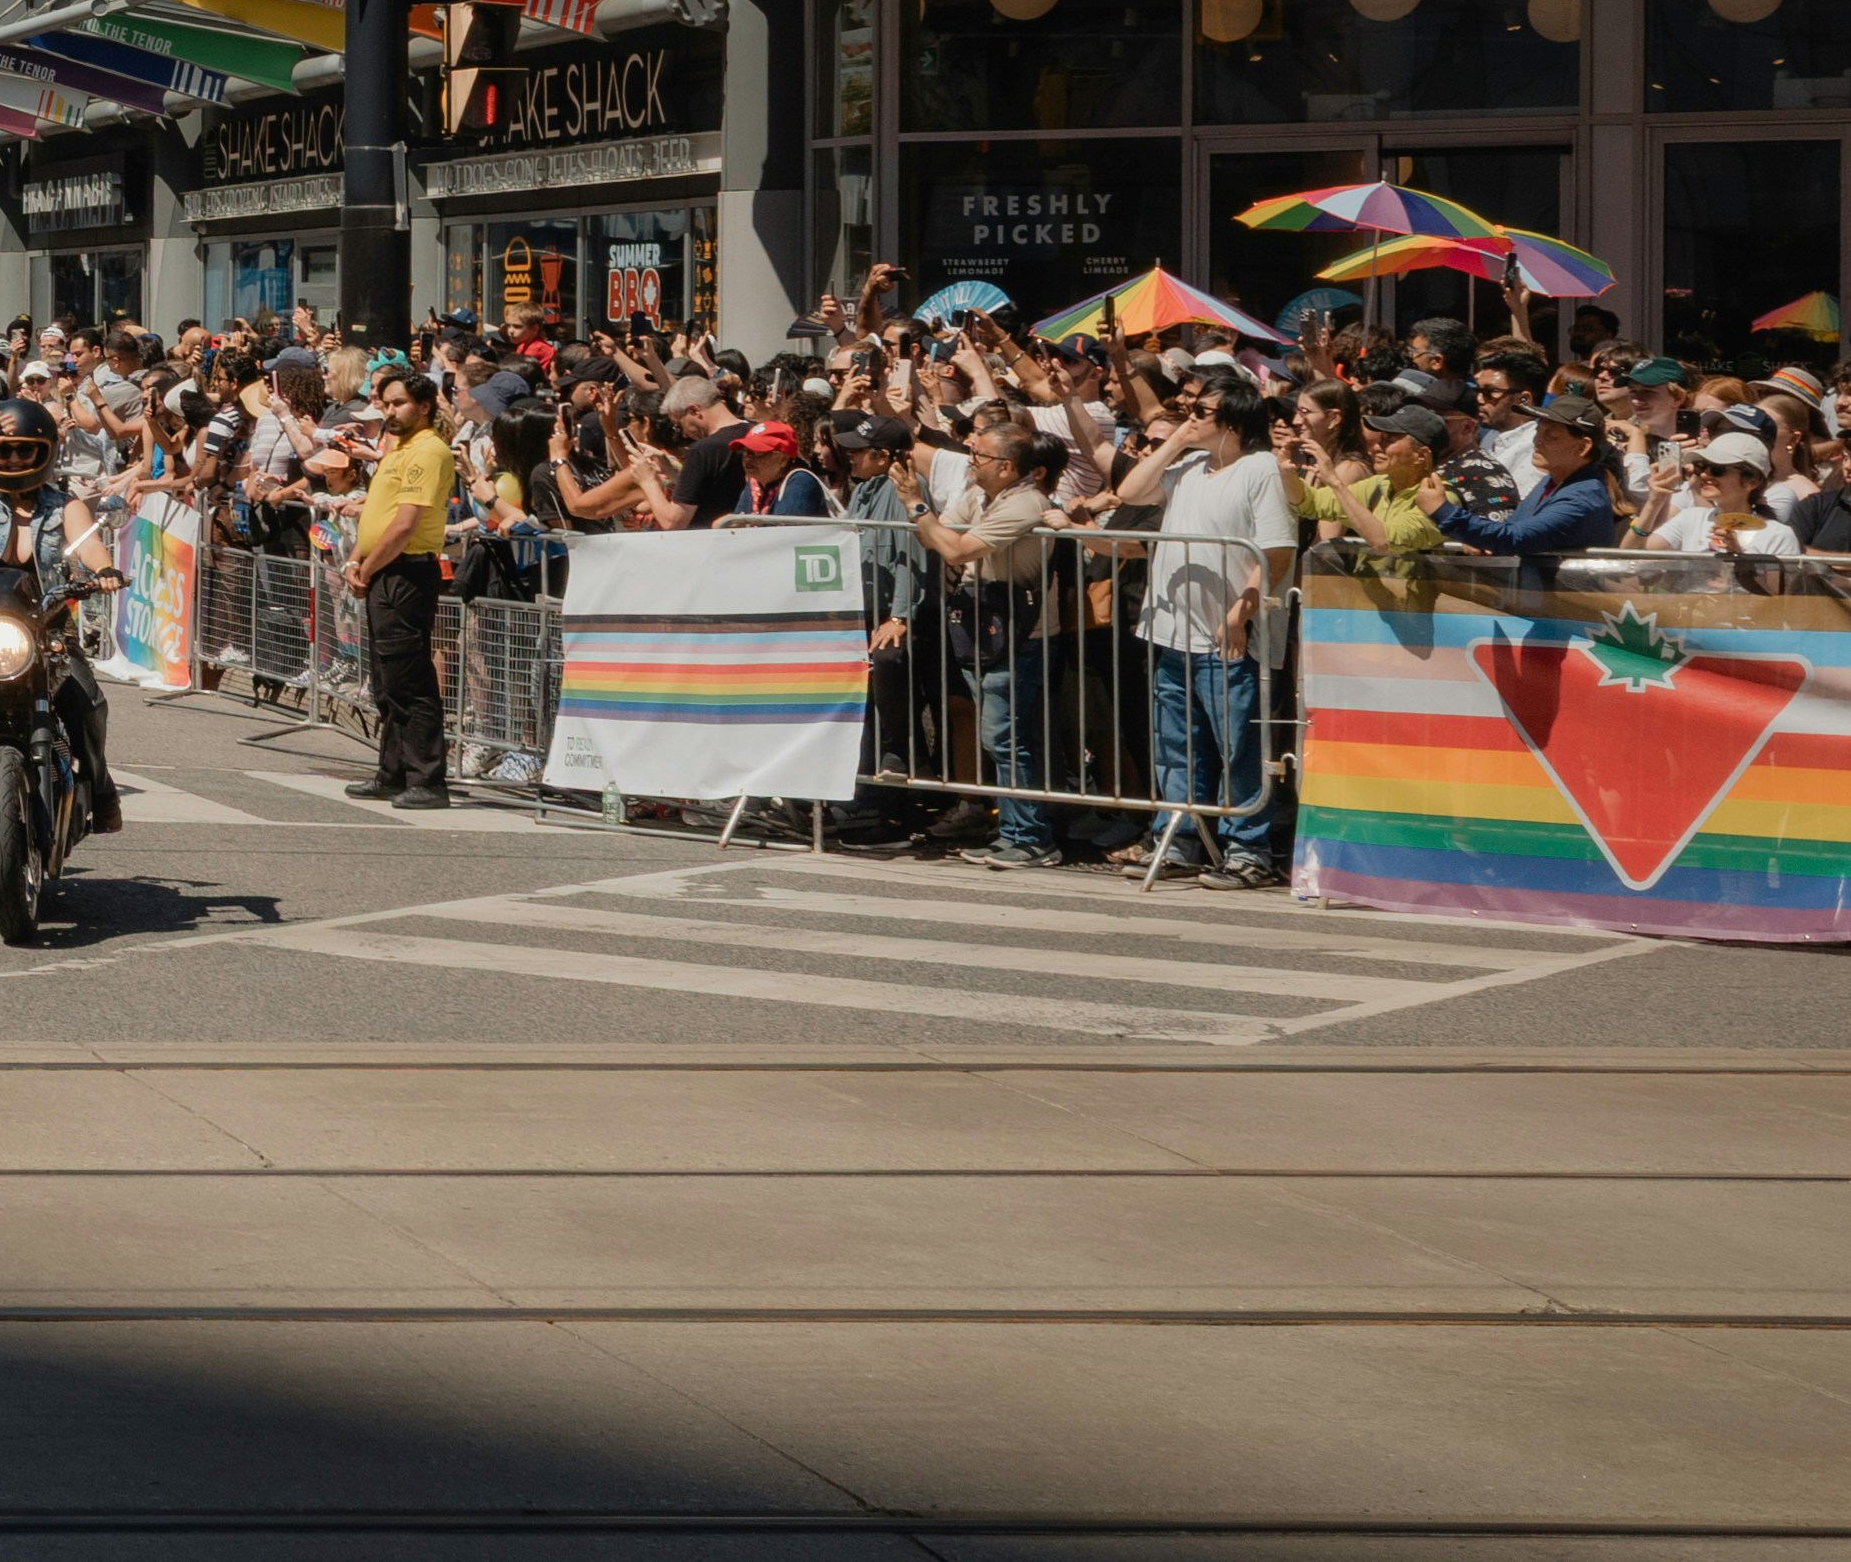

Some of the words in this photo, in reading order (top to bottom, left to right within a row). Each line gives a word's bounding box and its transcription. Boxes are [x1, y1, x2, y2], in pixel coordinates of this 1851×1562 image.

[104, 22, 128, 41] THE
[131, 30, 172, 55] TENOR
[19, 60, 57, 83] TENOR
[479, 68, 560, 147] AKE
[566, 49, 666, 137] SHACK
[218, 115, 277, 180] SHAKE
[281, 102, 346, 173] SHACK
[464, 161, 500, 192] DOGS
[591, 143, 645, 180] FLOATS
[962, 194, 1113, 216] FRESHLY
[973, 223, 1102, 245] PICKED
[609, 243, 661, 268] SUMMER
[942, 258, 1009, 266] STRAWBERRY
[1086, 257, 1126, 265] CHERRY
[947, 267, 1004, 275] LEMONADE
[1083, 266, 1129, 274] LIMEADE
[607, 268, 662, 331] BBQ
[798, 554, 836, 583] TD
